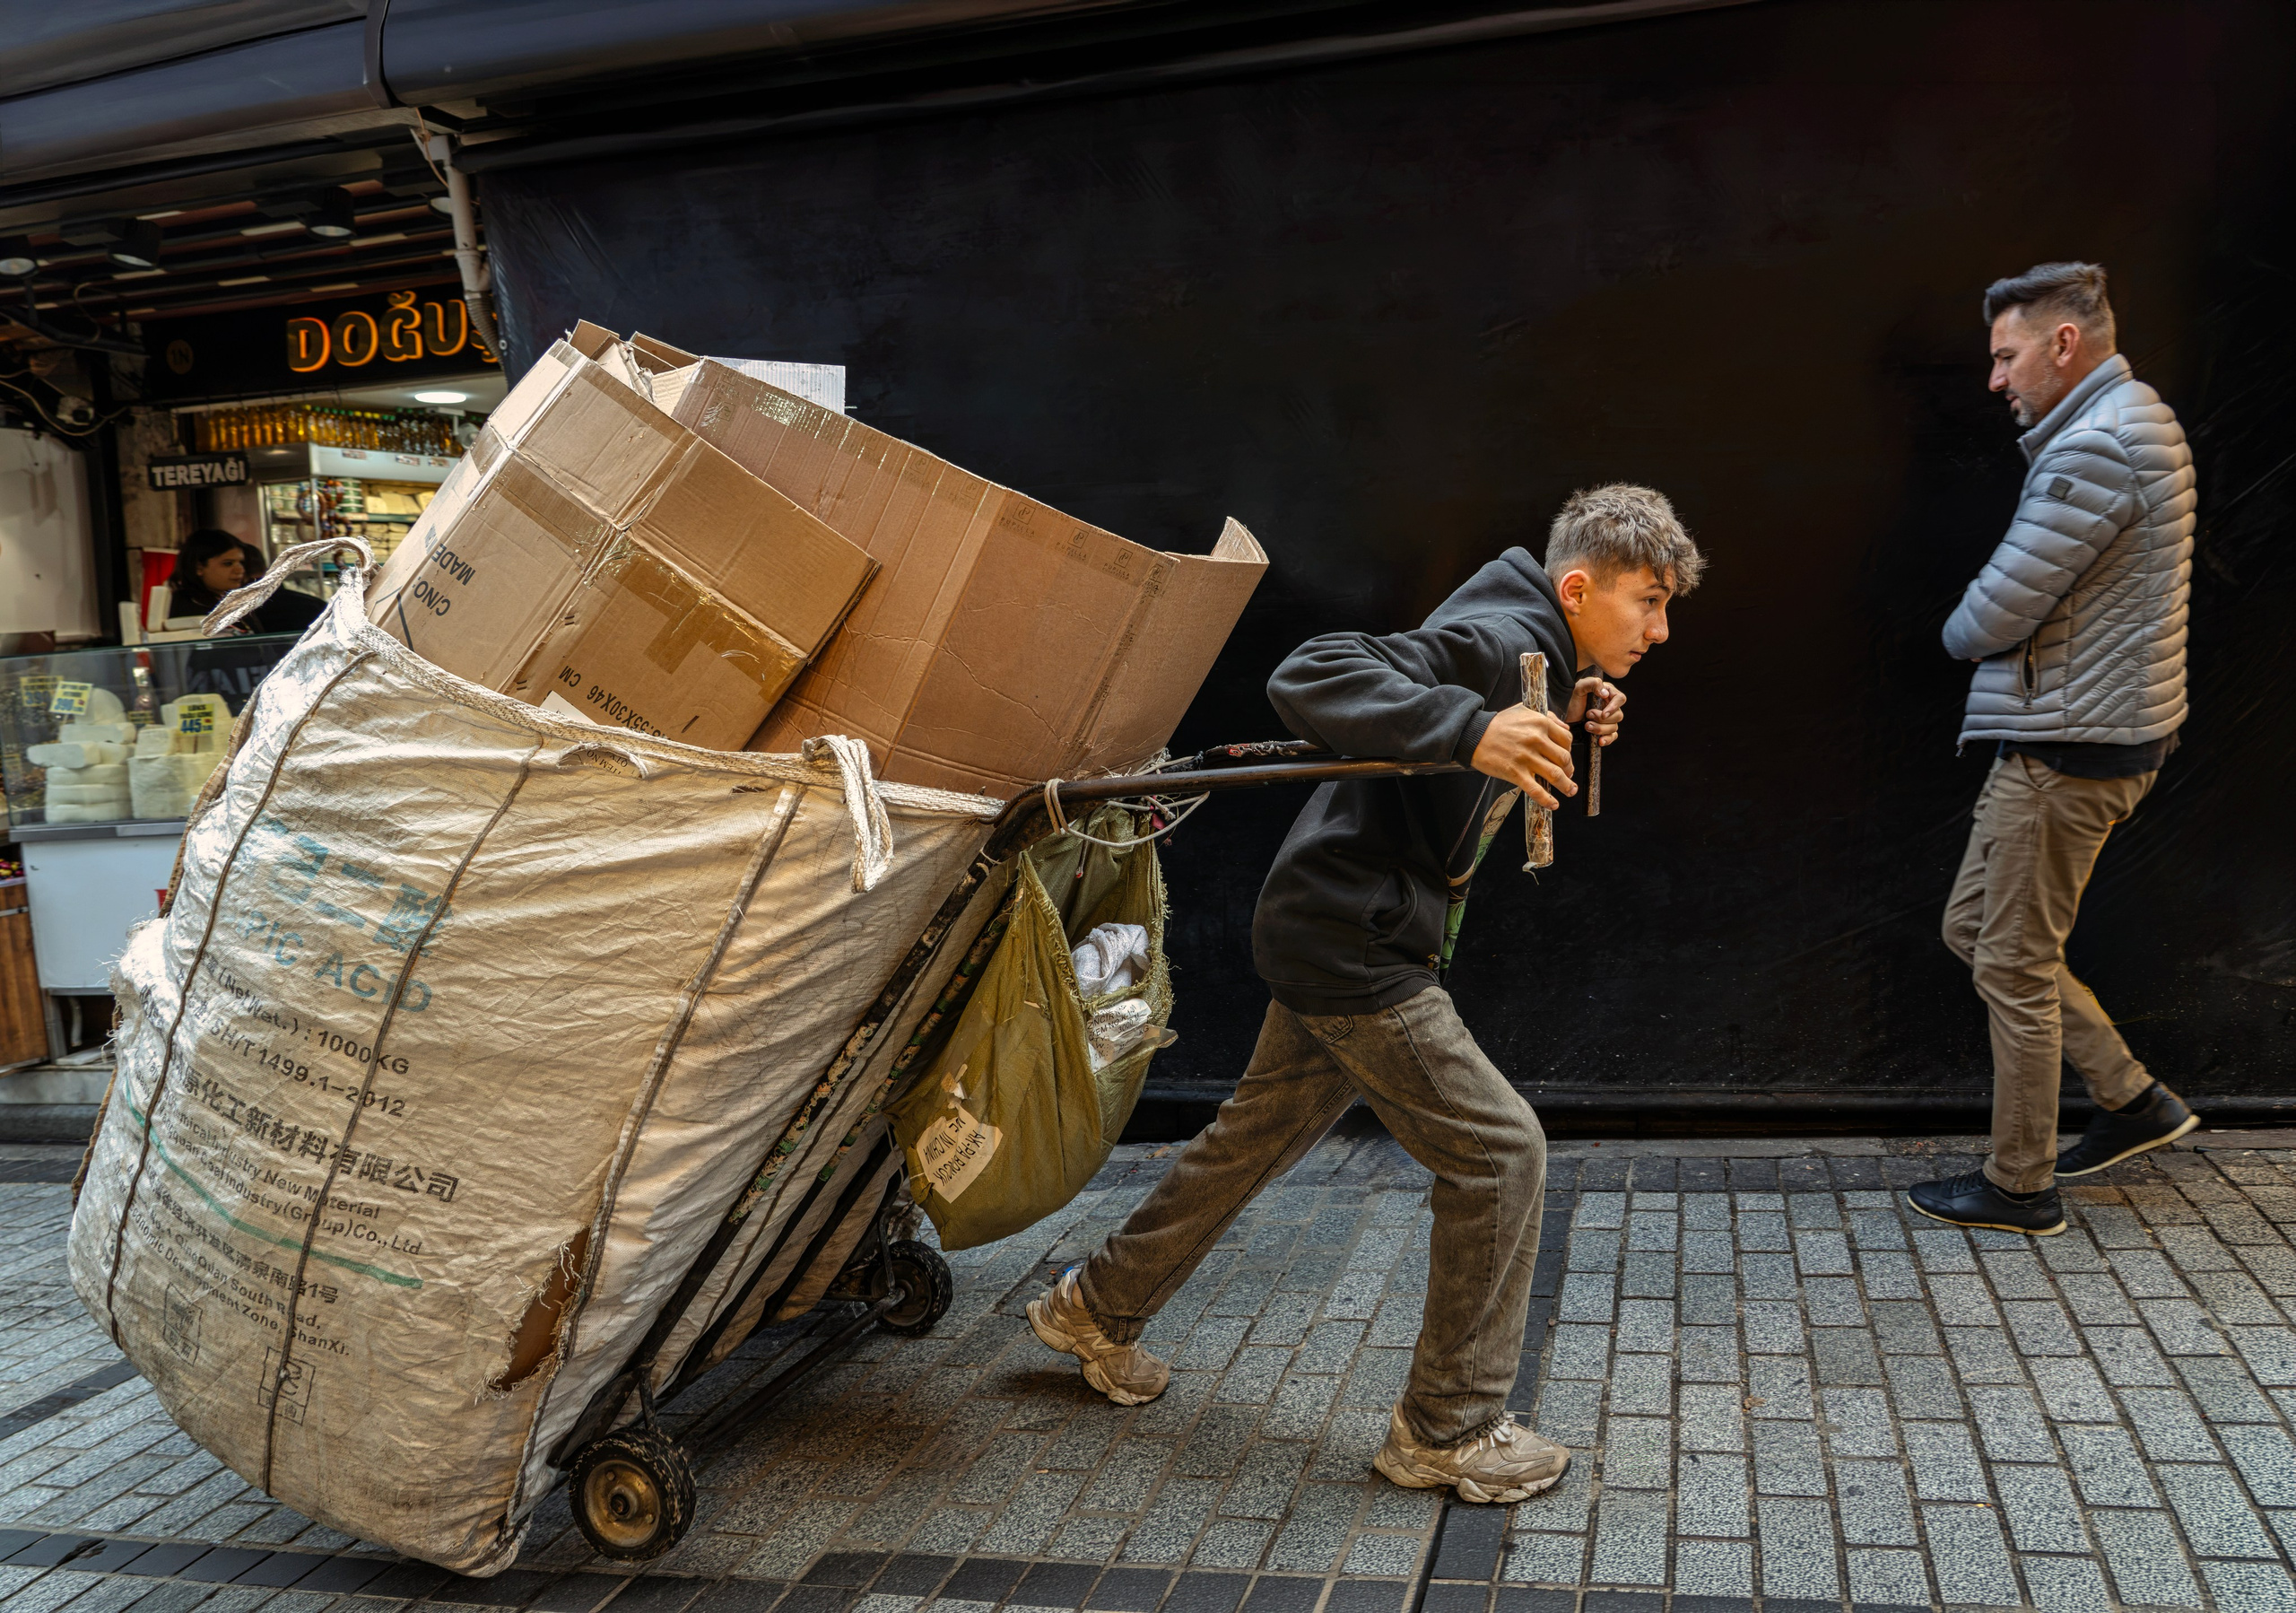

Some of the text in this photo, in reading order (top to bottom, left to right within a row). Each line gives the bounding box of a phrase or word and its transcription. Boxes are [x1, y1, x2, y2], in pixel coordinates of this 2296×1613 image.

[151, 457, 247, 487] TEREYAĞI
[1000, 517, 1035, 536] PUPILLA
[430, 544, 476, 586] MADE
[1057, 542, 1087, 559] PUPILLA
[1104, 563, 1130, 577] PUPILLA
[413, 577, 450, 616] C/NO:
[558, 665, 582, 688] CM
[586, 750, 601, 763] NO
[317, 1030, 411, 1075] 1000KG
[258, 1048, 406, 1118] 1499.1-2012
[176, 1059, 461, 1205] 原化工新材料有限公司
[263, 1169, 302, 1196] New
[230, 1277, 274, 1308] South
